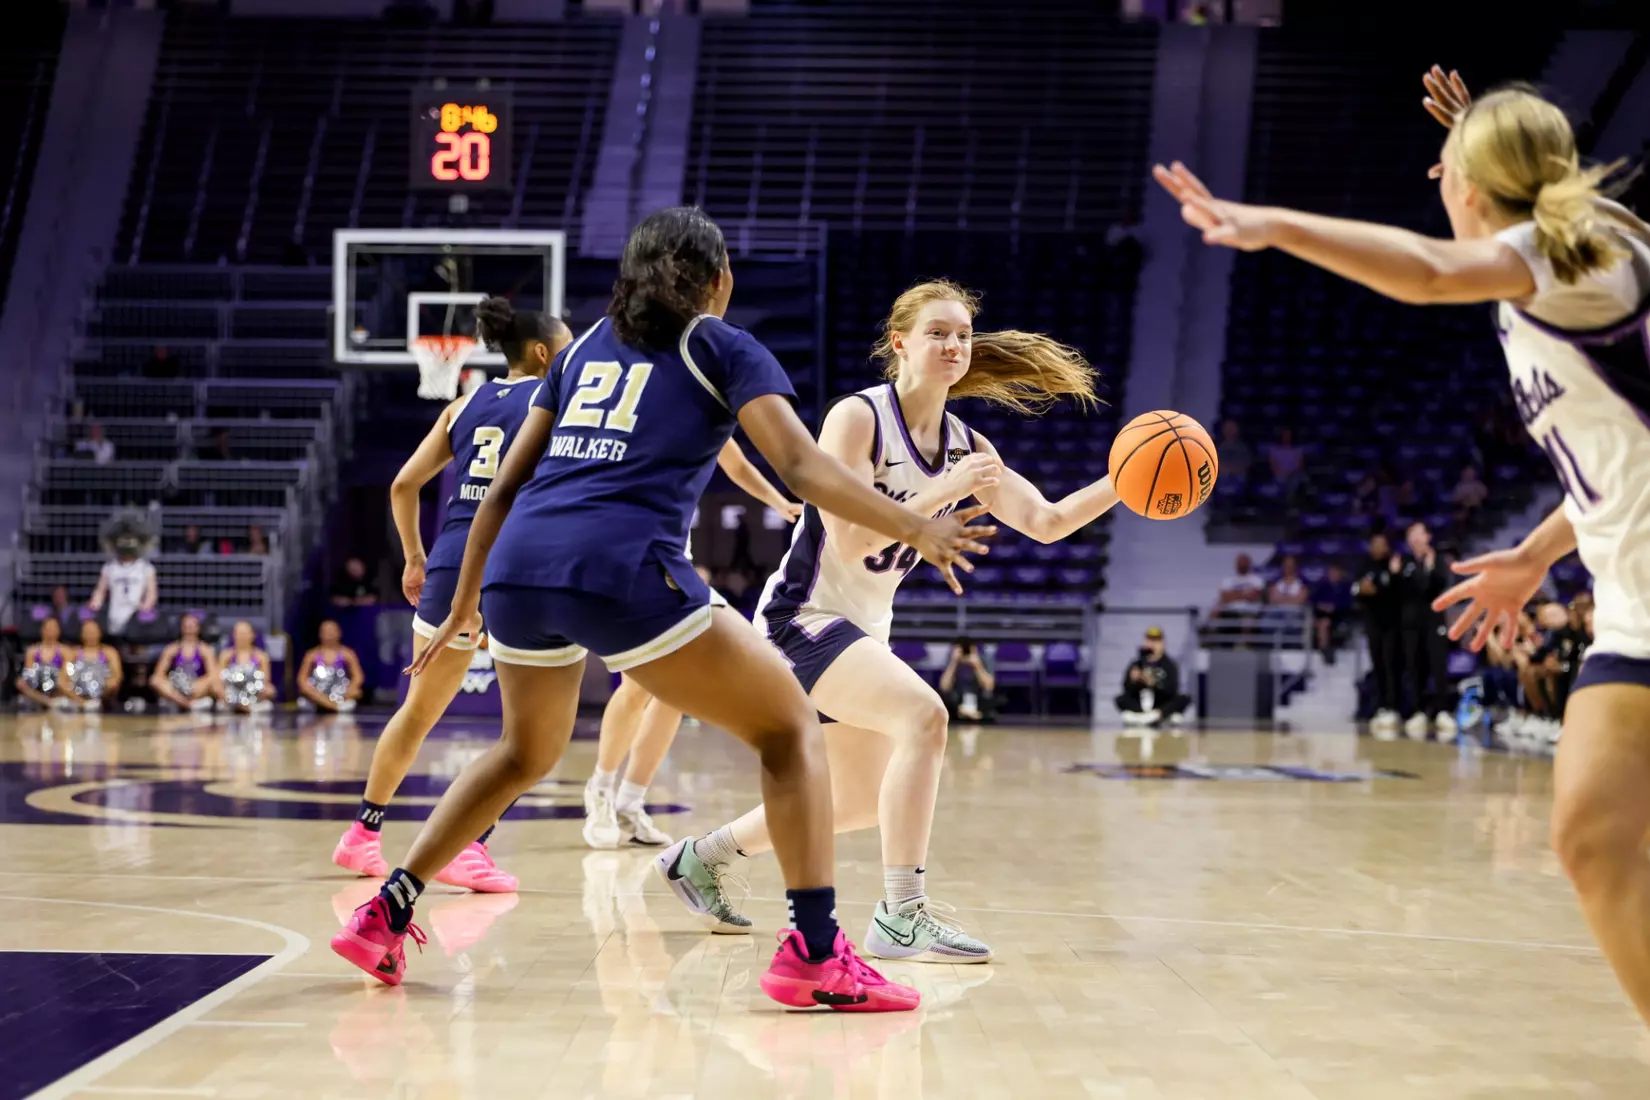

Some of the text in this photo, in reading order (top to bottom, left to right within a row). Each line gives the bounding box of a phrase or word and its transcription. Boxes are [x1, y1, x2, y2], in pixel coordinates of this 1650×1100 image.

[431, 131, 490, 181] 20
[558, 360, 654, 433] 21
[469, 426, 505, 479] 3
[549, 435, 628, 462] WALKER
[460, 483, 488, 501] MOO
